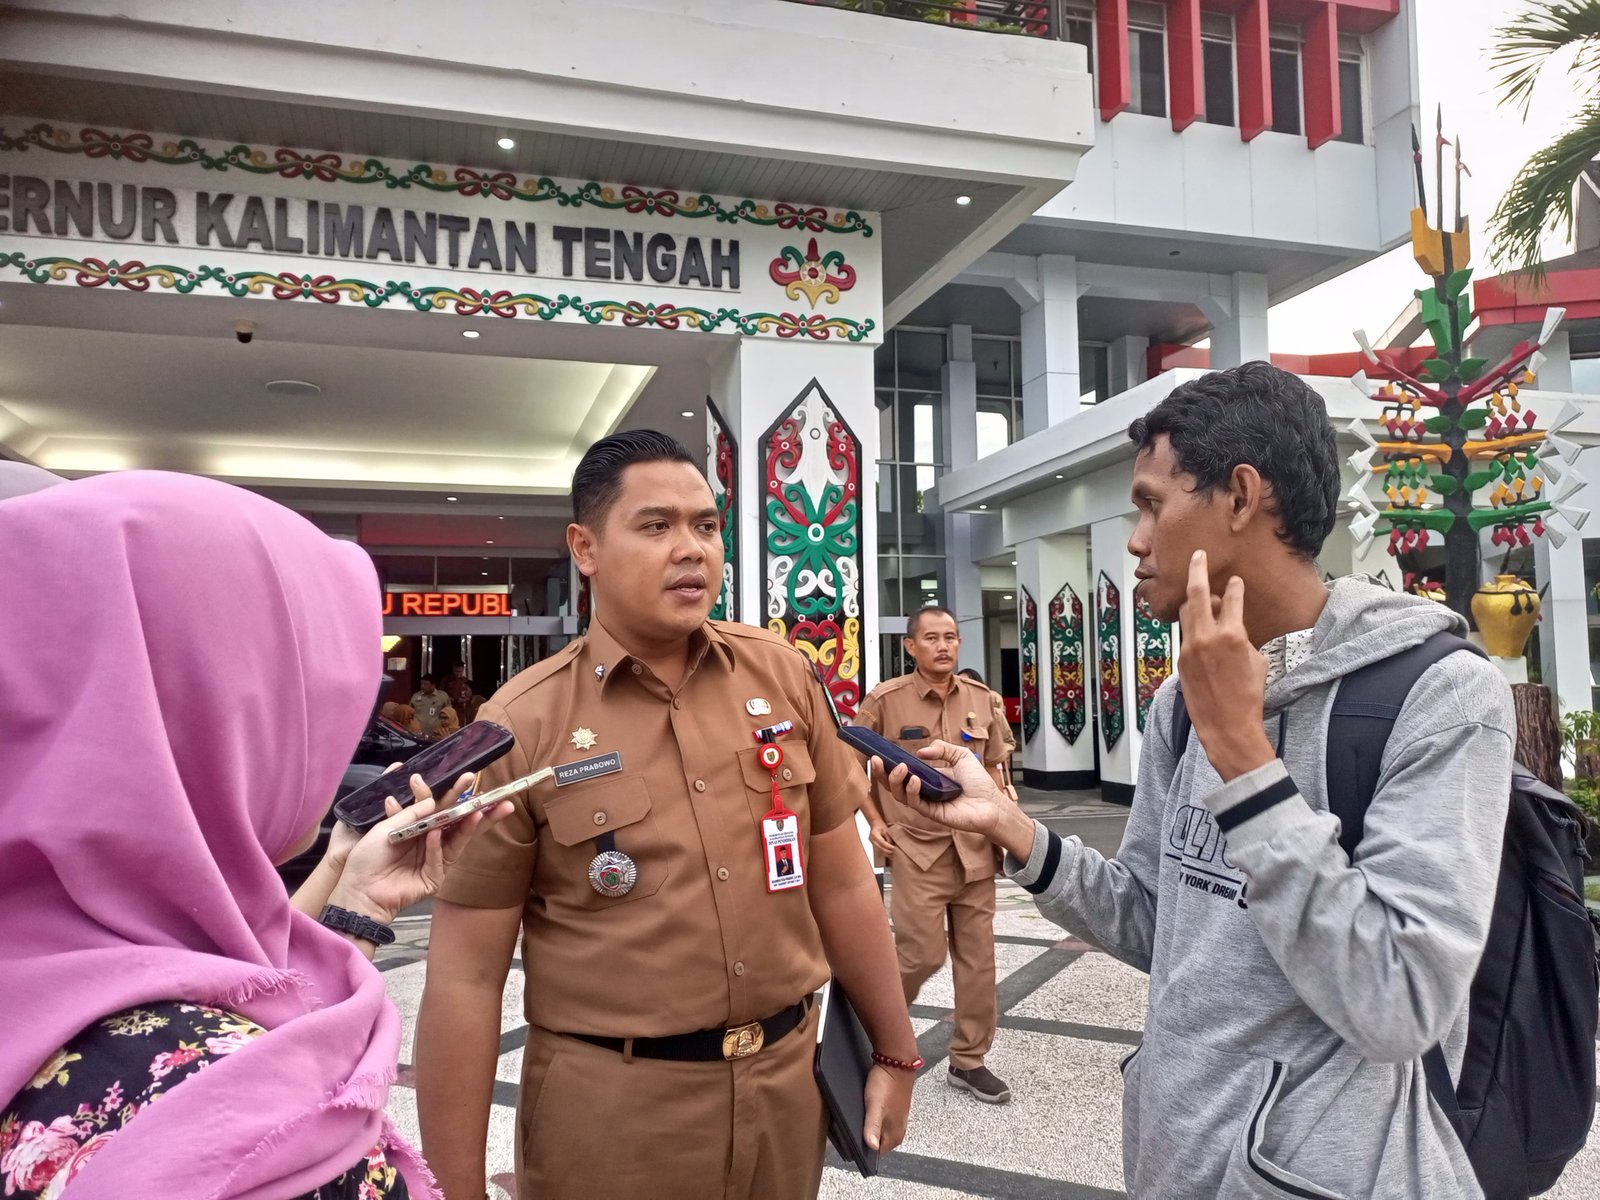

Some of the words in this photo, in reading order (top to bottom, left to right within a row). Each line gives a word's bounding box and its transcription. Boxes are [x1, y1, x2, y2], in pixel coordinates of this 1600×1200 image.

[195, 191, 536, 273] KALIMANTAN
[553, 225, 740, 289] TENGAH
[559, 768, 579, 778] REZA
[580, 758, 616, 774] PRABOWO
[1185, 873, 1211, 892] YORK
